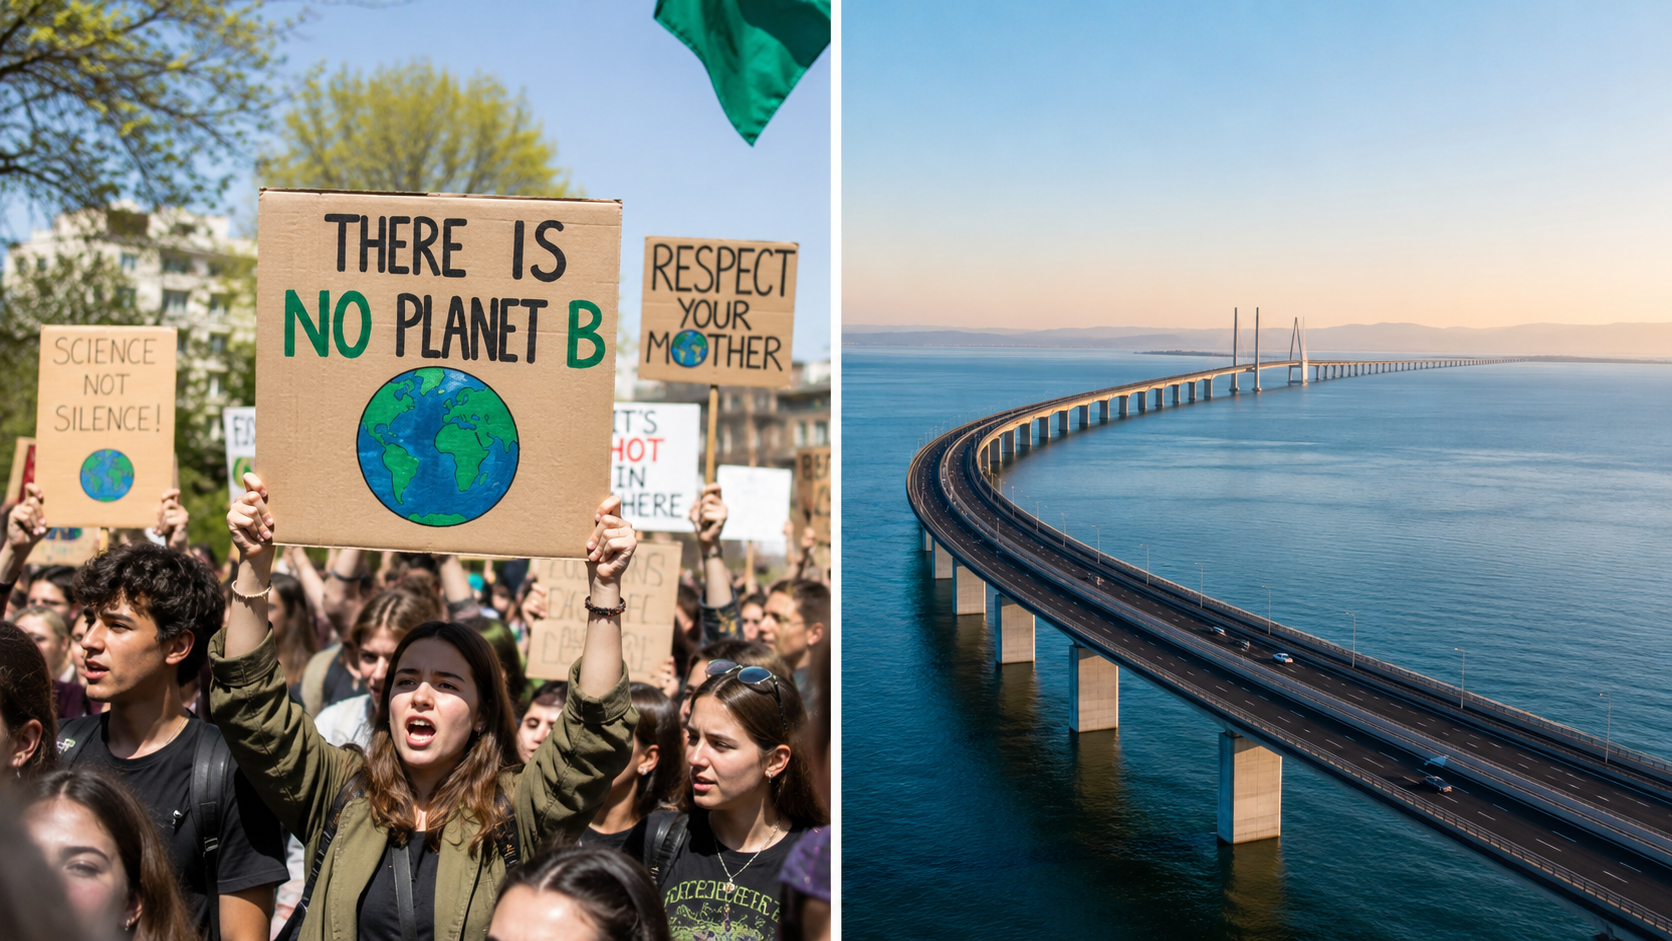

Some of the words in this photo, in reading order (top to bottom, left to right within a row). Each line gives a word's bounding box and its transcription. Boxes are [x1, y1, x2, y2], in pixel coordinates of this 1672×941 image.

[324, 213, 468, 278] THERE
[512, 219, 567, 283] IS
[652, 243, 796, 298] RESPECT
[284, 289, 372, 359] NO
[395, 292, 548, 364] PLANET
[566, 299, 606, 369] B
[677, 297, 752, 331] YOUR
[53, 336, 157, 366] SCIENCE
[84, 373, 130, 396] NOT
[54, 403, 161, 433] SILENCE!
[613, 409, 658, 435] IT'S
[612, 437, 665, 462] HOT
[616, 465, 646, 489] IN
[621, 492, 683, 519] HERE
